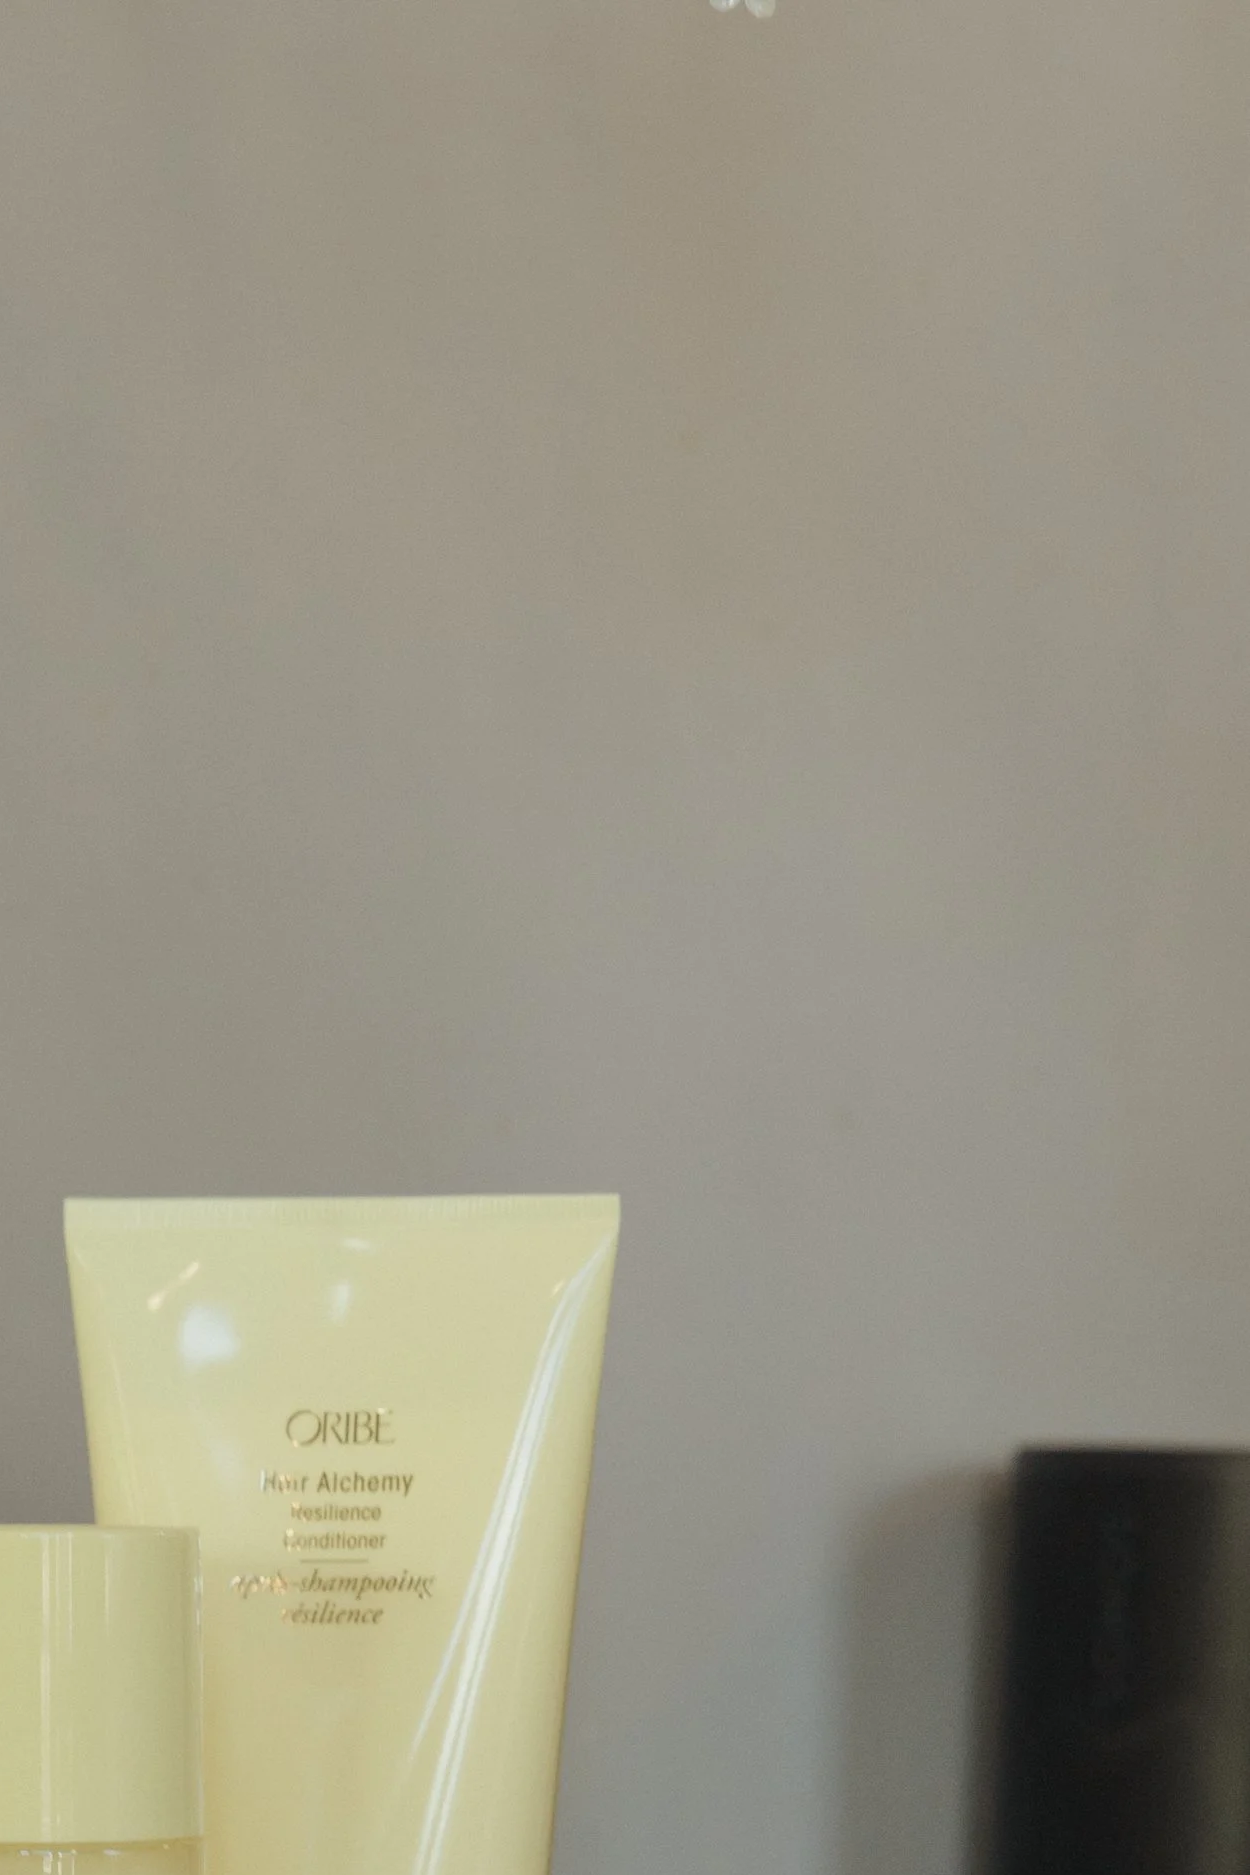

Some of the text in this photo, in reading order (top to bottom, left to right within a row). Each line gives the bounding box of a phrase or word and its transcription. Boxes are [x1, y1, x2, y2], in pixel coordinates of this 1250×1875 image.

[285, 1409, 396, 1447] ORIBE
[261, 1469, 415, 1498] Hair Alchemy
[290, 1503, 383, 1522] Resilience
[283, 1529, 387, 1551] Conditioner
